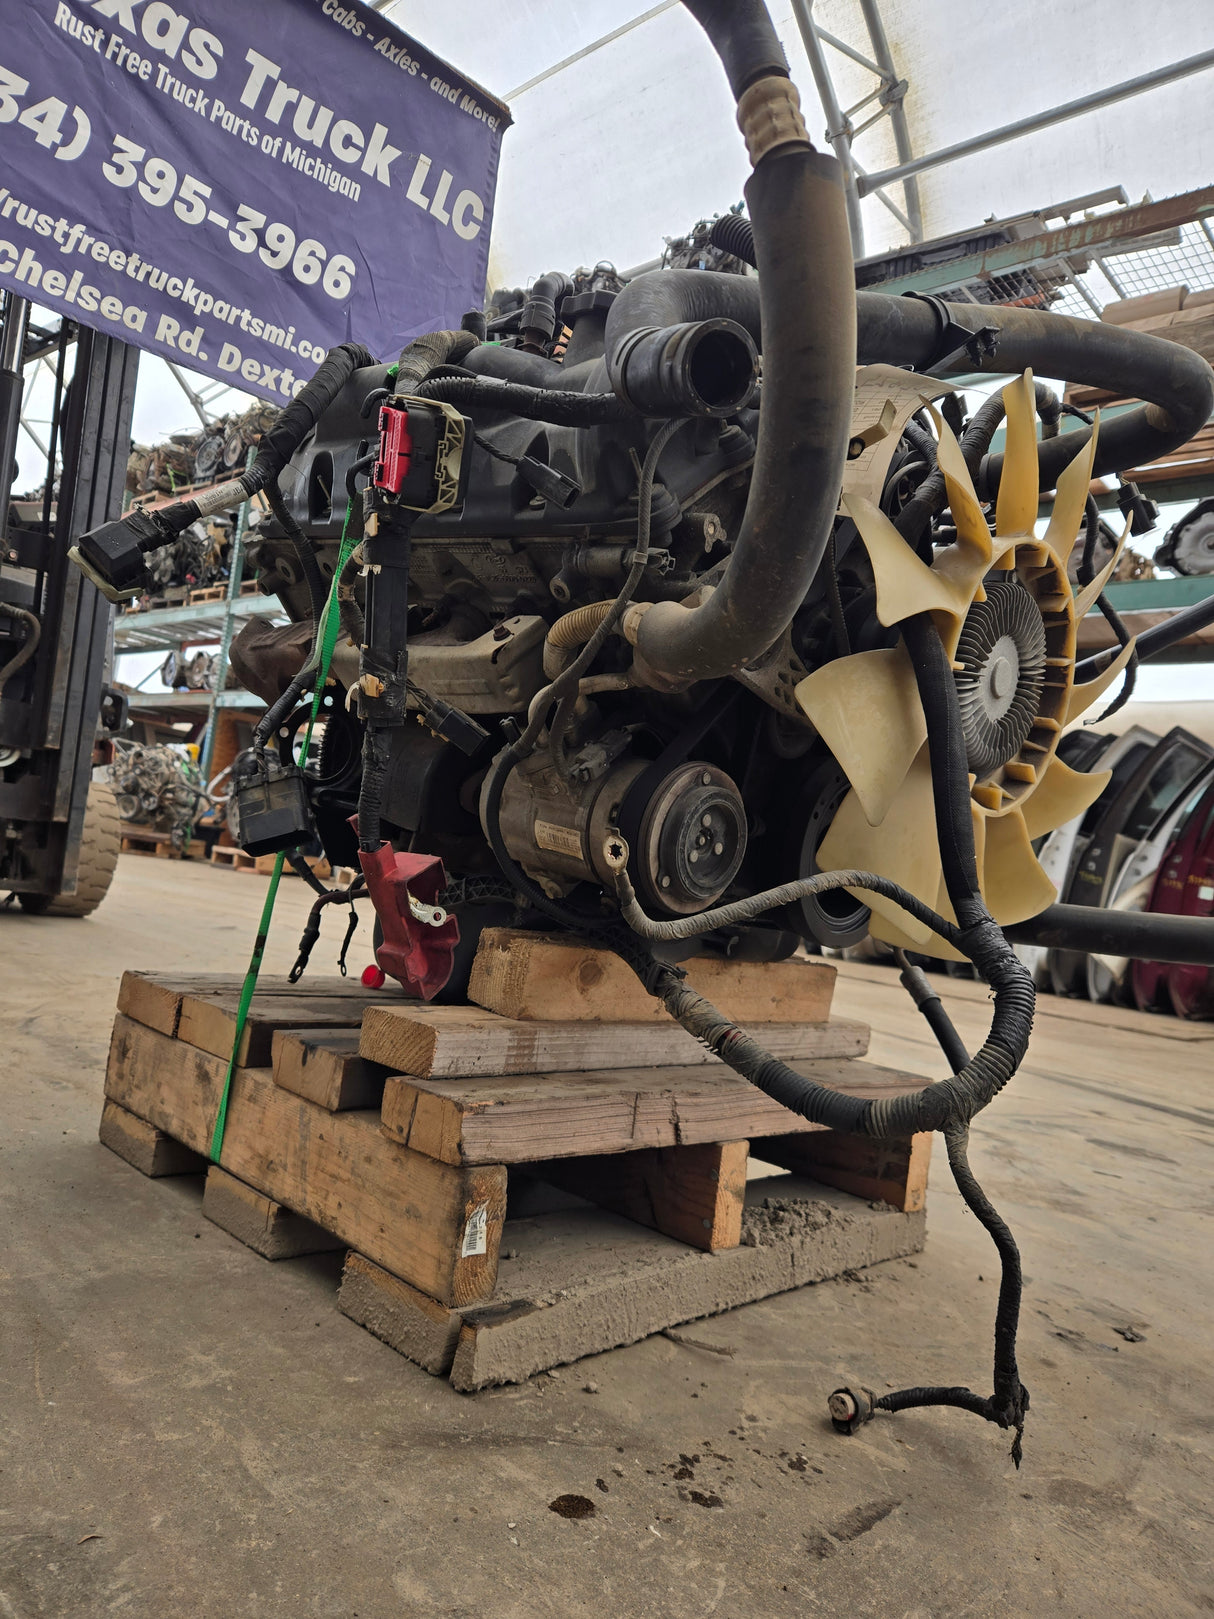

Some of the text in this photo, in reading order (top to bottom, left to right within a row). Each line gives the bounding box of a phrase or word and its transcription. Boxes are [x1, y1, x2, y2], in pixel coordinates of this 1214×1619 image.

[54, 1, 361, 202] Rust Free Truck Parts of Michigan
[79, 0, 484, 241] xas Truck LLC
[321, 0, 366, 37] Cabs
[373, 37, 420, 76] Axles
[430, 76, 462, 104] and
[459, 94, 500, 133] More!
[0, 65, 356, 300] 34) 395-3966
[0, 188, 329, 364] rustfreetruckpartsmi.co
[0, 239, 309, 398] Chelsea Rd. Dexte
